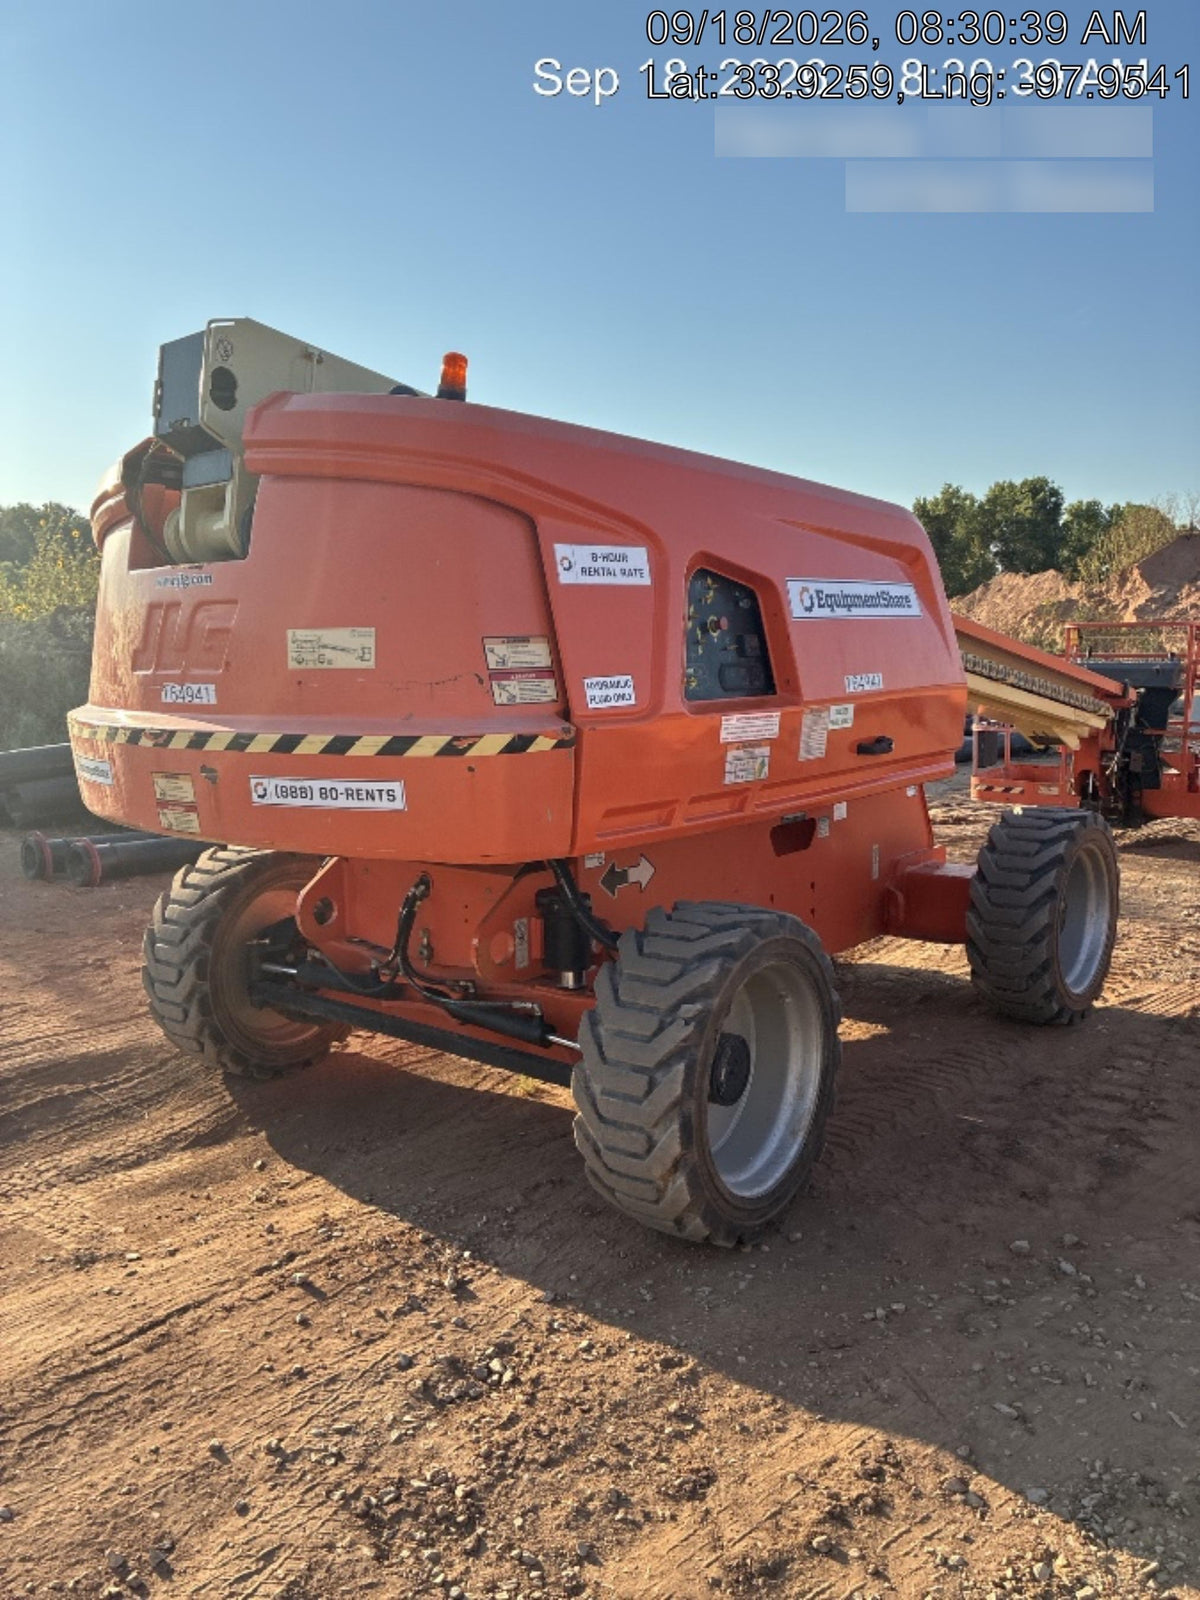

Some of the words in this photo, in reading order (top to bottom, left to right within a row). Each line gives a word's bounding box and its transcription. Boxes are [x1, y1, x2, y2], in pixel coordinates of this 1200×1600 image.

[591, 552, 629, 564] 8-HOUR
[580, 566, 618, 578] RENTAL
[619, 568, 645, 579] RATE
[815, 589, 912, 612] EquipmentShare
[131, 599, 239, 675] JLG
[274, 783, 314, 801] (888)
